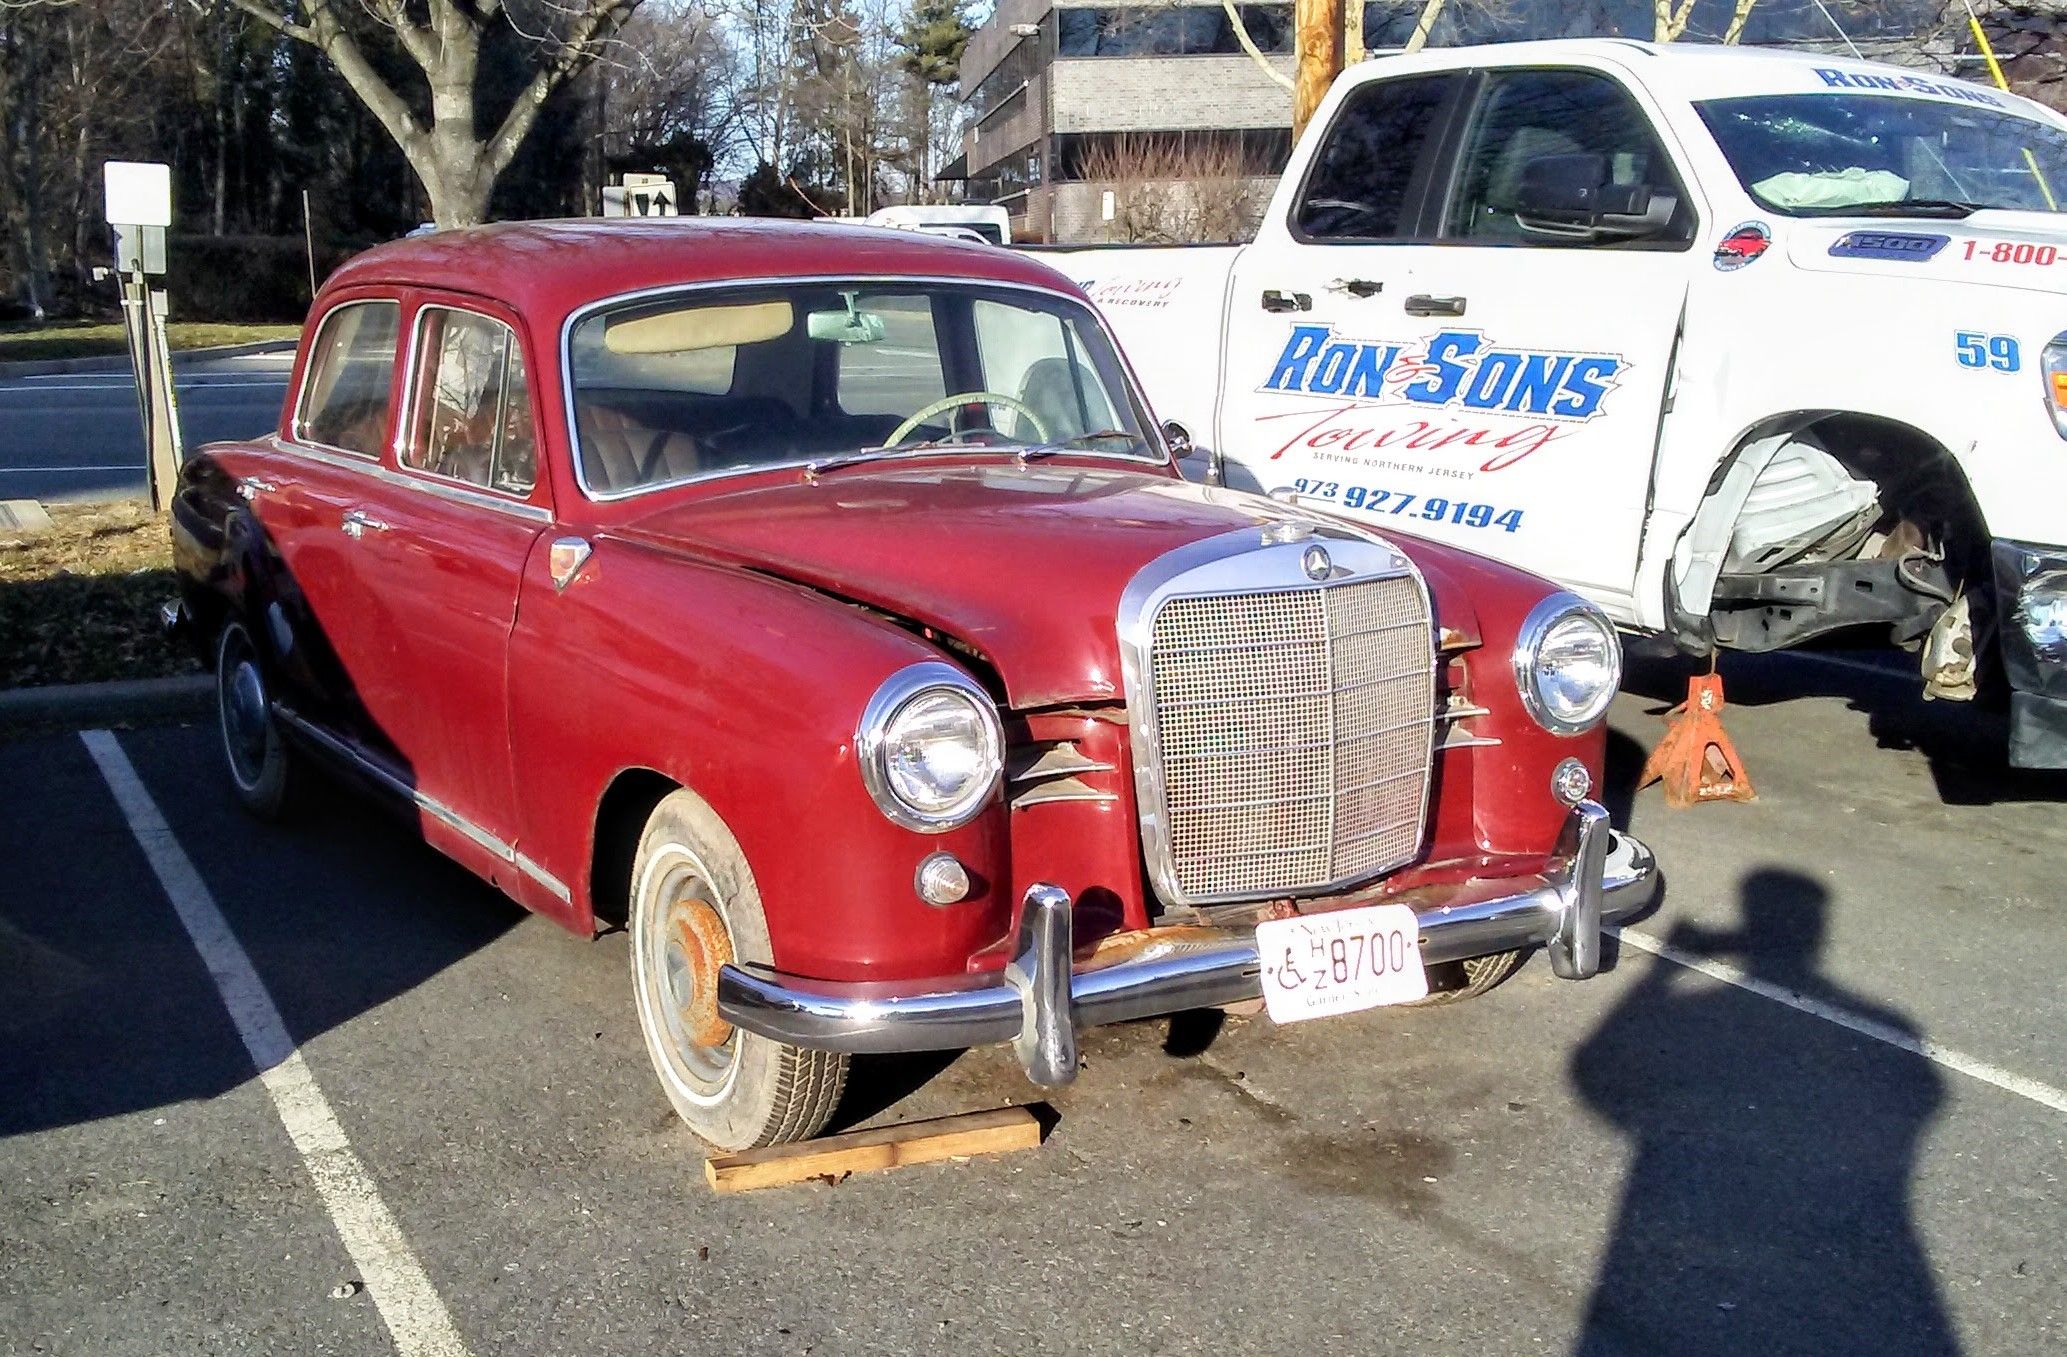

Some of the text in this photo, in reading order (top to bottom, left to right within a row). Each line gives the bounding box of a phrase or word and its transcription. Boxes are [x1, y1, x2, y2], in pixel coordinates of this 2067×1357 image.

[1107, 298, 1169, 308] RECOVERY
[1264, 325, 1401, 398] RON
[1403, 332, 1619, 418] SONS
[1956, 331, 2021, 373] 59
[1254, 403, 1576, 472] Towing
[1312, 451, 1475, 480] SERVING NORTHERN JERSEY
[1294, 477, 1525, 533] 973 927.9194
[1330, 930, 1404, 984] 8700
